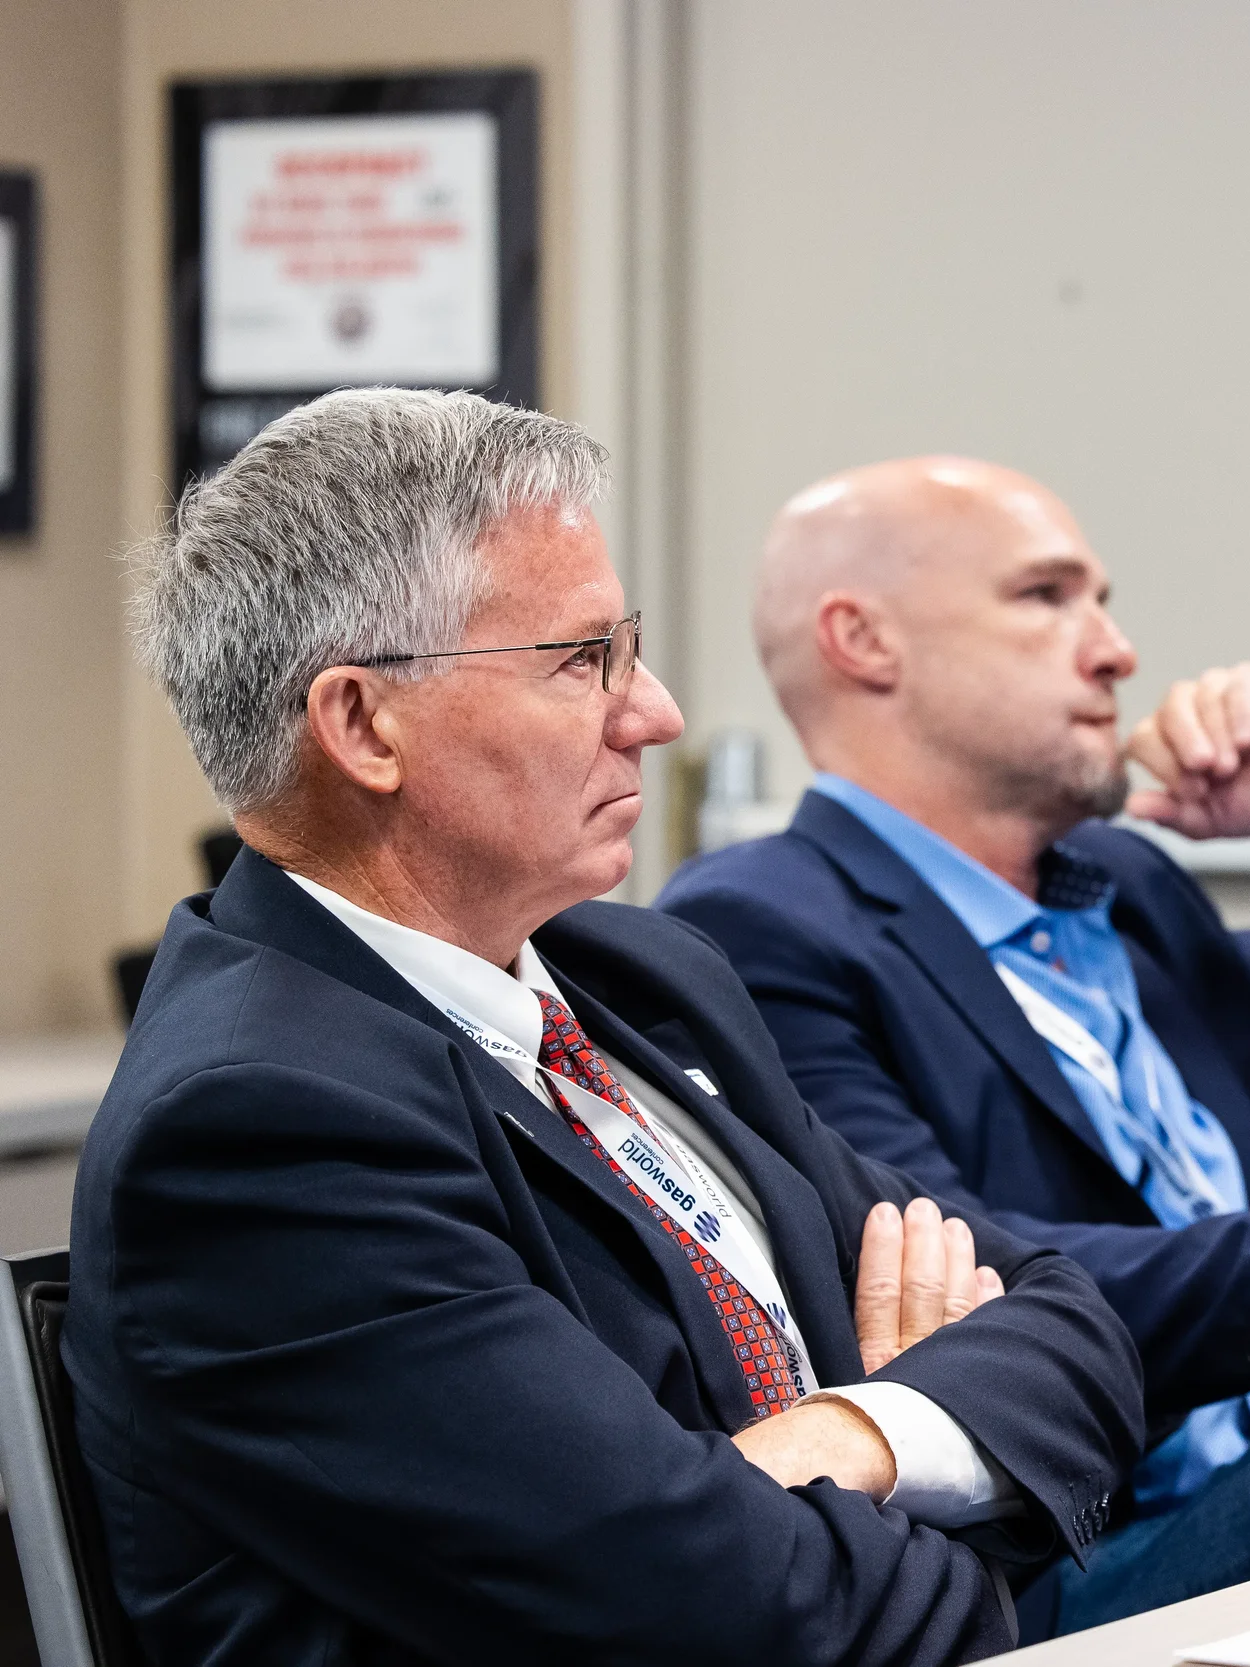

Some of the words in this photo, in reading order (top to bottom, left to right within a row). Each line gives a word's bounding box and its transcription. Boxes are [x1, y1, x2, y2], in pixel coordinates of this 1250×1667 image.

[445, 1008, 484, 1034] conferences
[631, 1132, 664, 1166] conferences
[617, 1138, 696, 1212] gasworld
